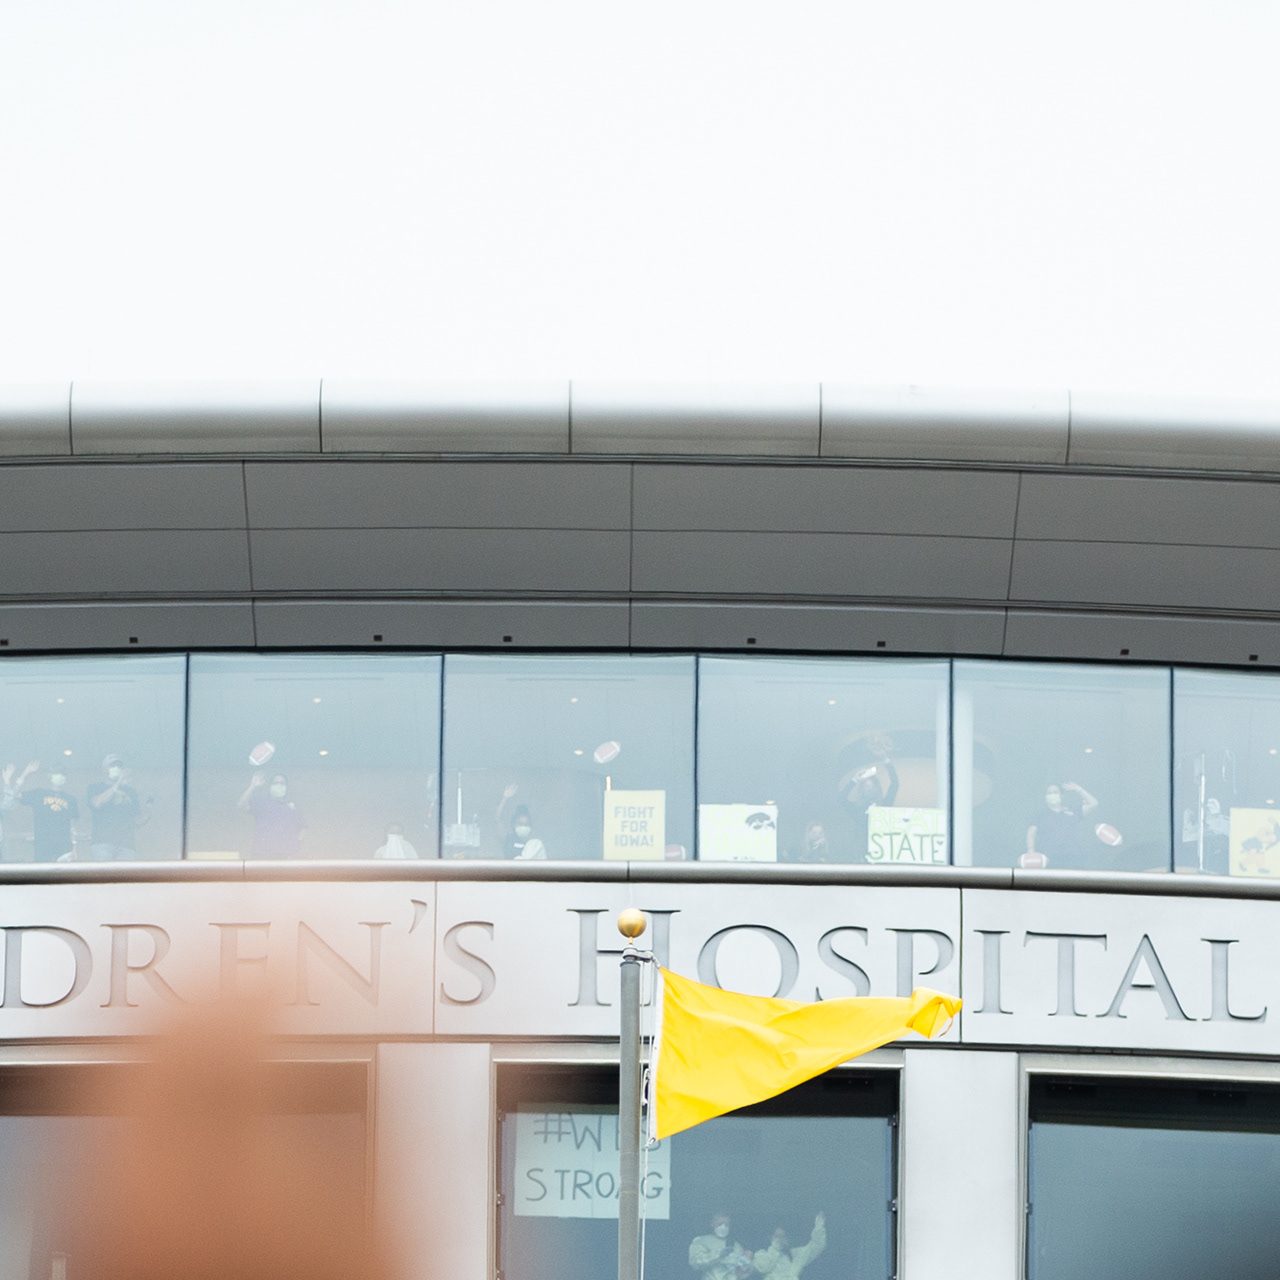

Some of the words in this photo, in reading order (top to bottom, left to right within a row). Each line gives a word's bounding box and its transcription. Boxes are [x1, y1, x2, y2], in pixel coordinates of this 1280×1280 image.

[613, 806, 655, 819] FIGHT
[869, 807, 945, 834] BEAT
[620, 820, 648, 833] FOR
[613, 834, 654, 847] IOWA!
[868, 833, 945, 863] STATE
[566, 908, 1268, 1023] HOSPITAL
[525, 1168, 664, 1202] STROG
